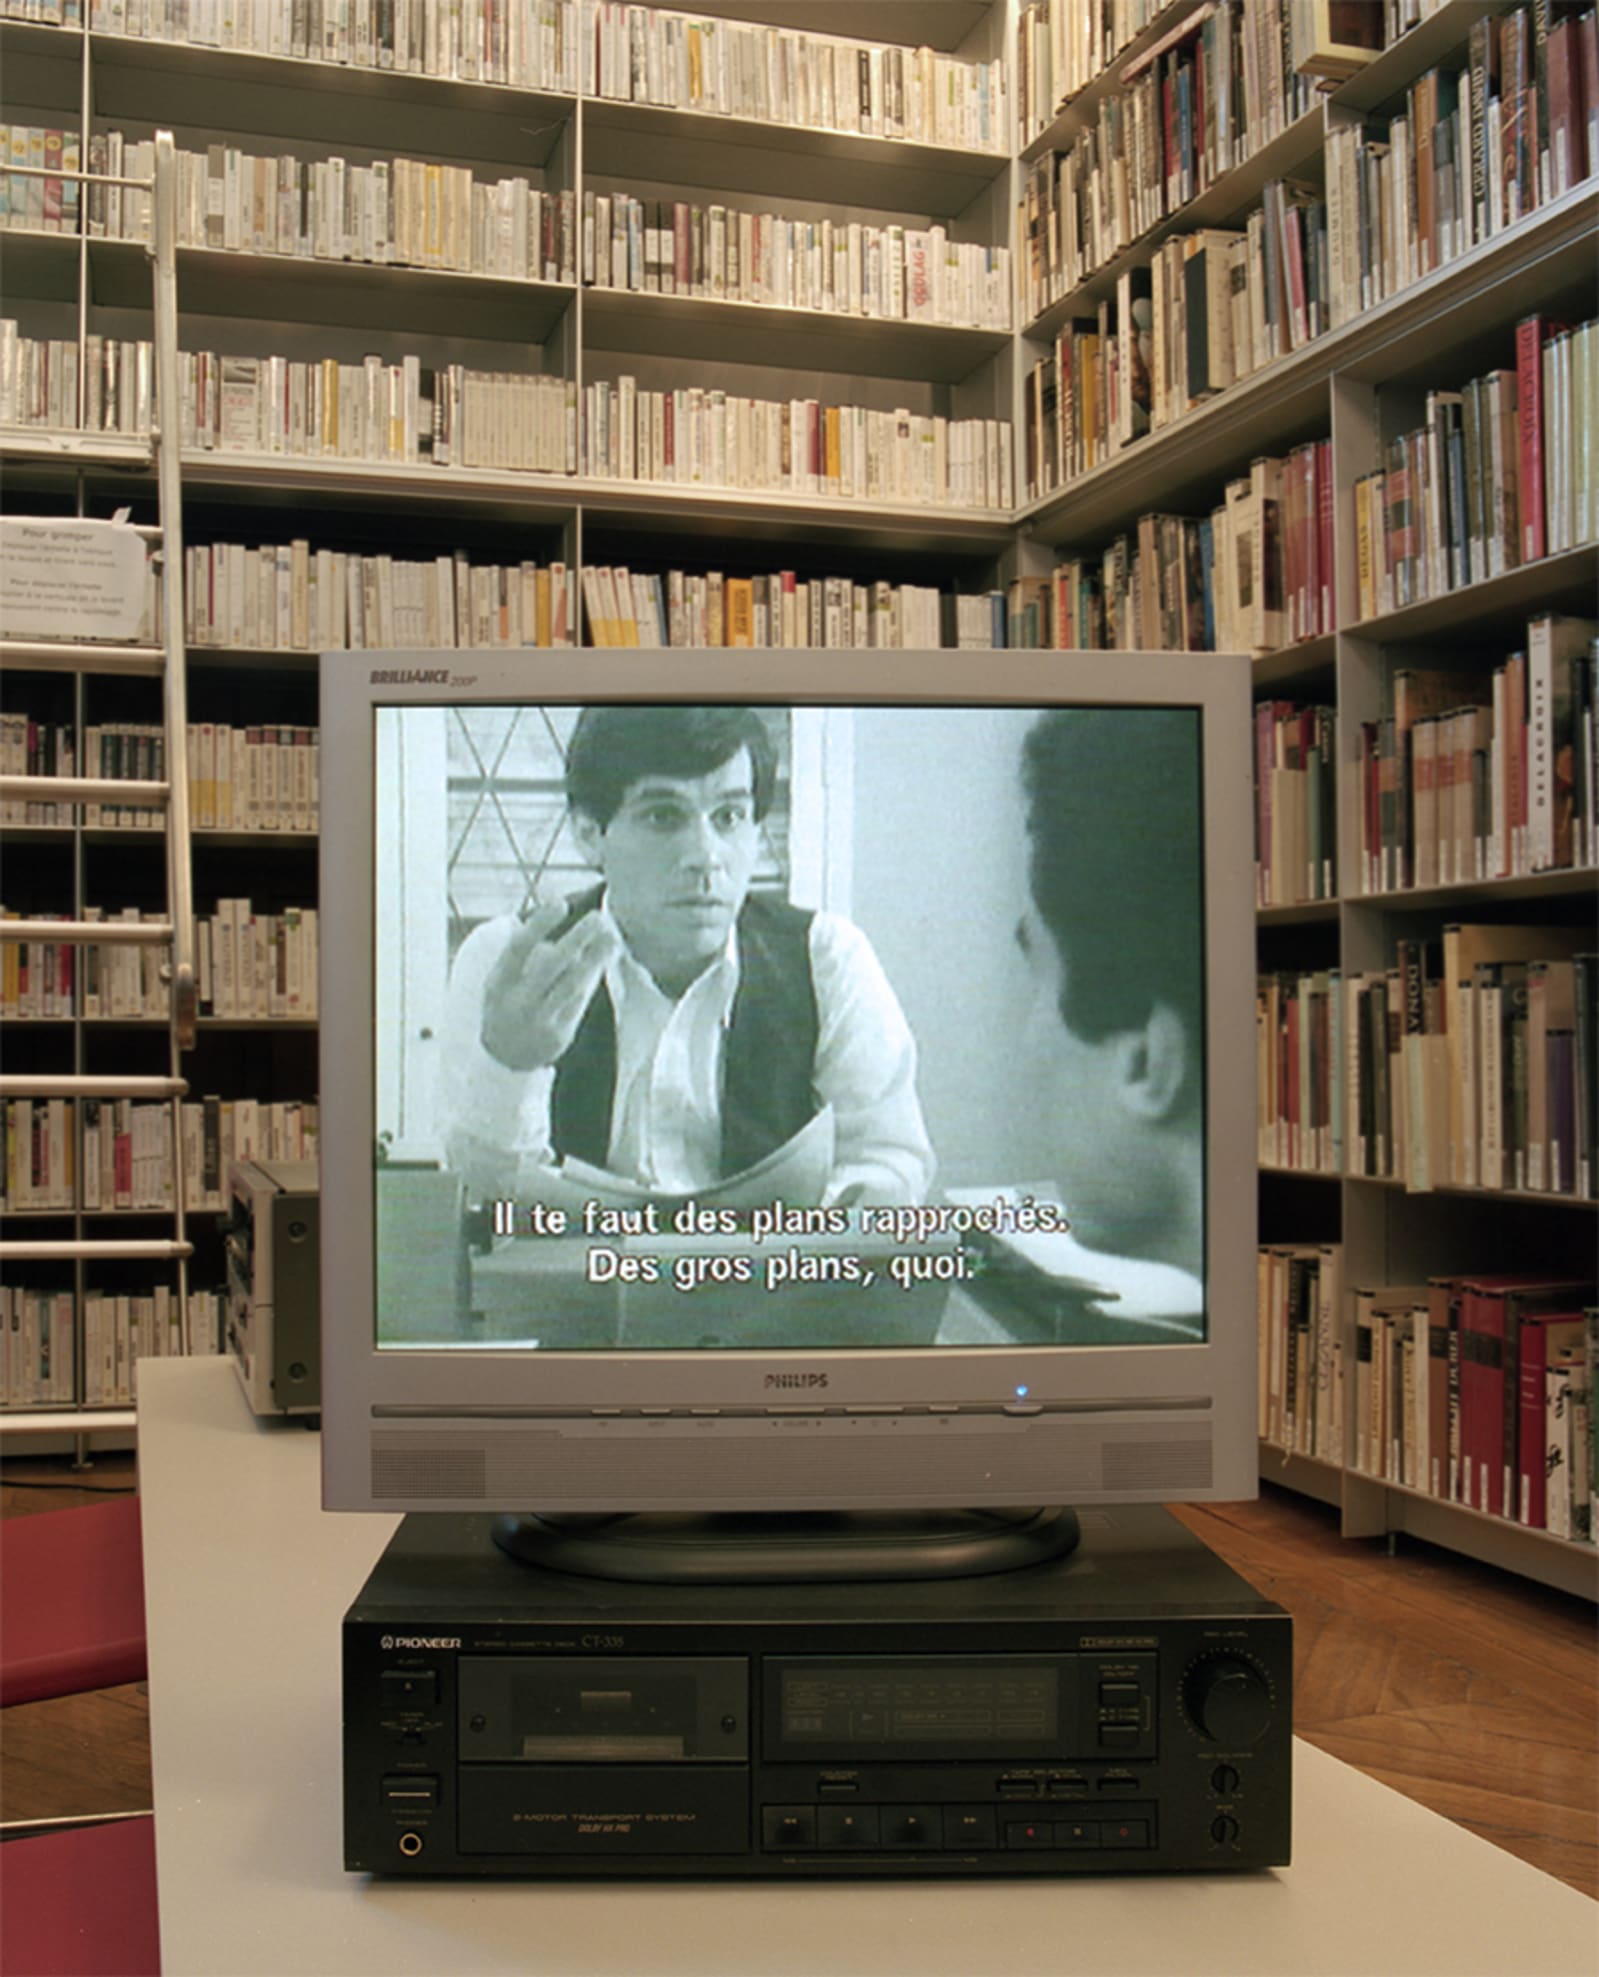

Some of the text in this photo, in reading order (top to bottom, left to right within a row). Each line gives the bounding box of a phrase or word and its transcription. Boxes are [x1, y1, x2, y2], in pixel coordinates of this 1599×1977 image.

[1472, 66, 1485, 118] DAVID
[1521, 325, 1536, 445] DELACROIX
[370, 670, 449, 684] BRILLIANCE
[494, 1200, 1068, 1243] Il te faut des plans rapprochés.
[588, 1248, 976, 1289] Des gros plans, quoi.
[764, 1373, 829, 1388] PHILIPS
[395, 1637, 461, 1649] PIONEER
